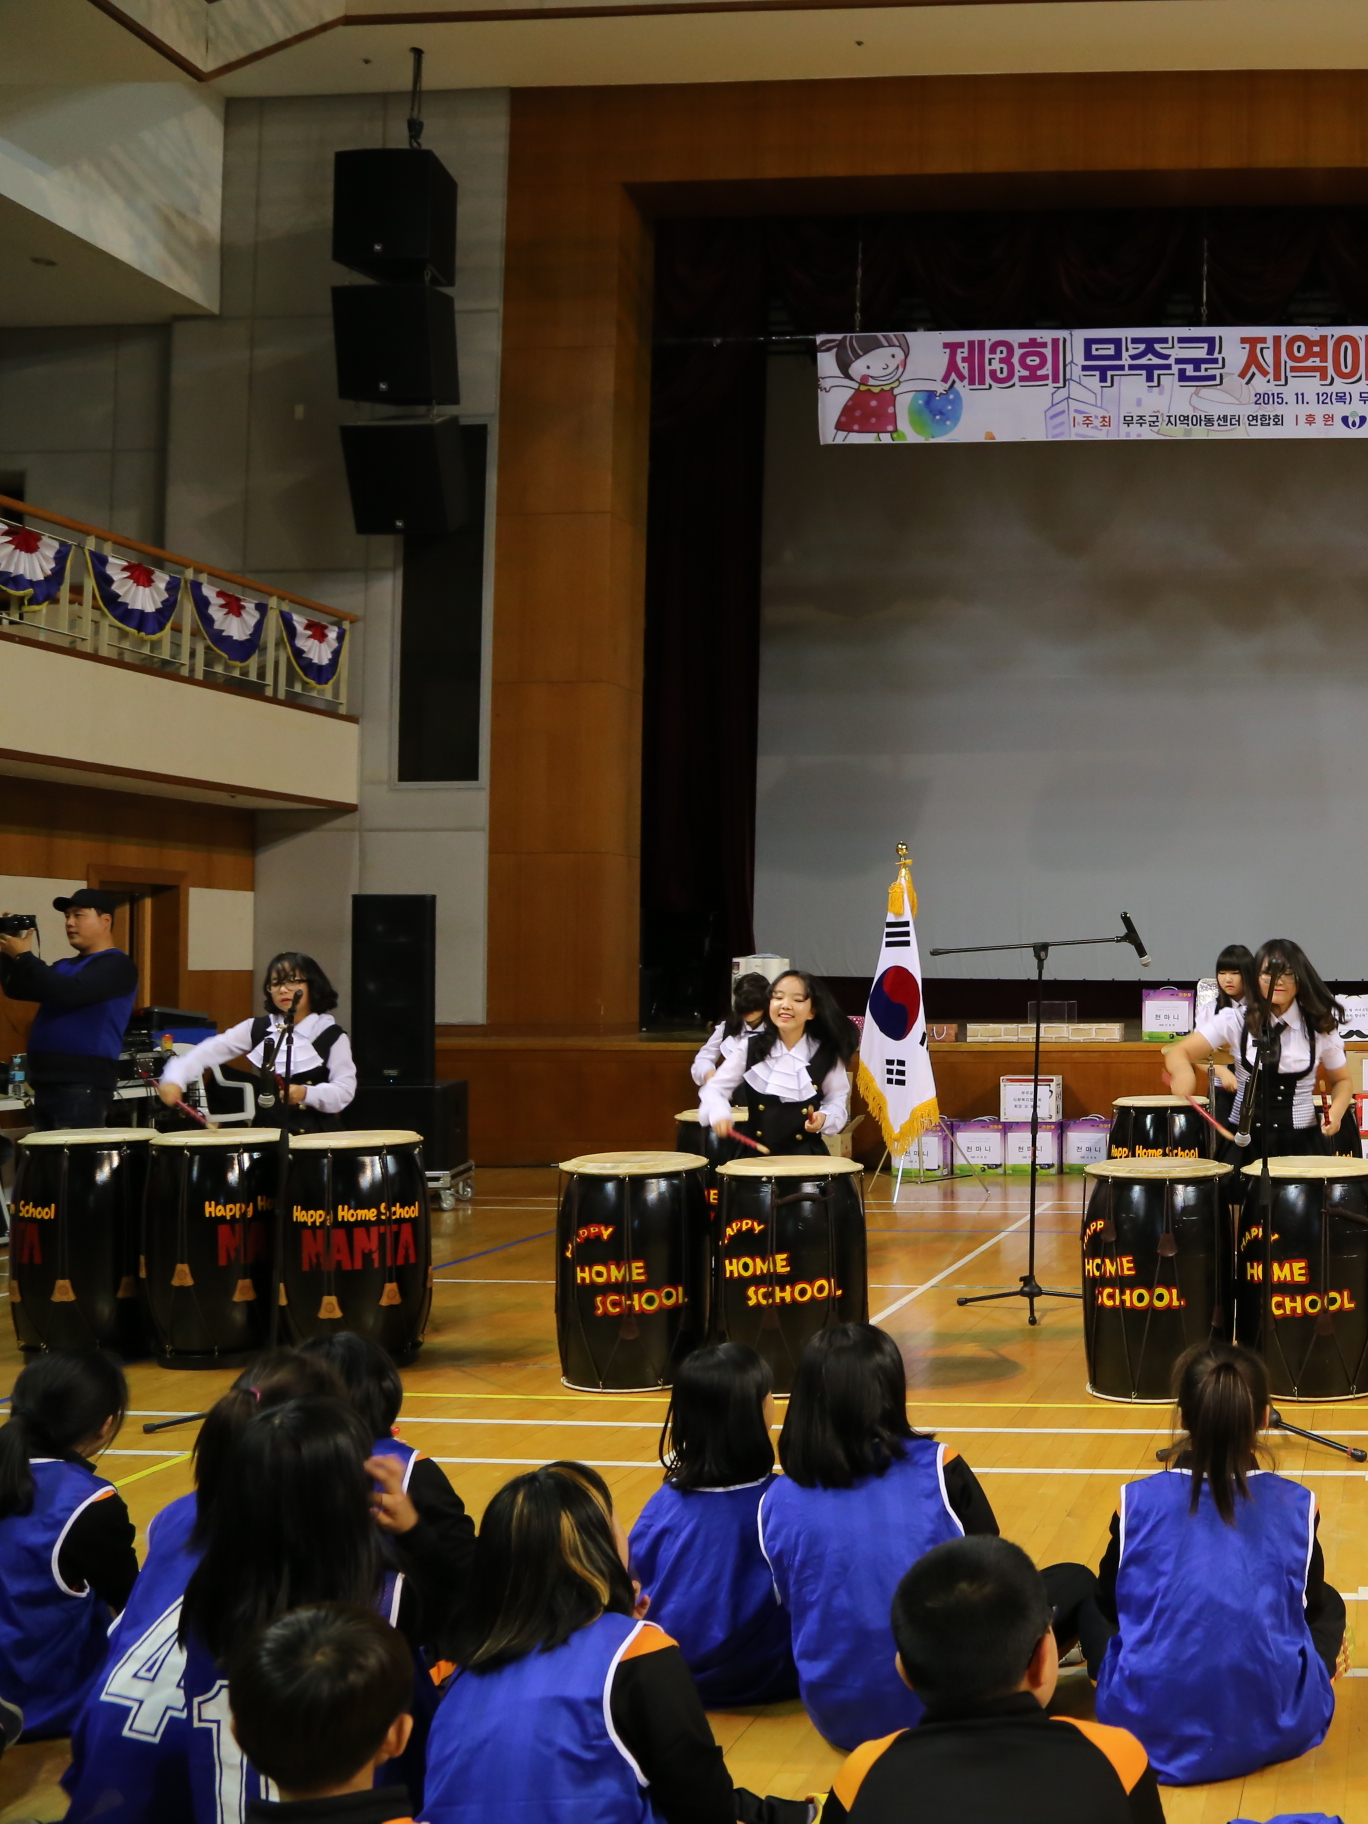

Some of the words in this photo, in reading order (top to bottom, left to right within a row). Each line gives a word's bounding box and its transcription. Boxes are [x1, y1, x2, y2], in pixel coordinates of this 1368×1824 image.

[941, 337, 1064, 387] 제3회
[1081, 336, 1221, 384] 무주군
[1254, 392, 1288, 405] 2015.
[1294, 392, 1309, 405] 11.
[1315, 391, 1353, 405] 12(목)
[1122, 414, 1160, 428] 무주군
[1166, 414, 1241, 428] 지역아동센터
[1246, 414, 1284, 427] 연합회
[1135, 1145, 1163, 1158] Home
[19, 1200, 56, 1220] School
[204, 1201, 254, 1220] Happy
[337, 1204, 378, 1222] Home
[380, 1201, 419, 1220] School
[576, 1260, 647, 1284] HOME
[724, 1252, 790, 1279] HOME
[1084, 1255, 1136, 1278] HOME
[595, 1285, 688, 1316] SCHOOL
[746, 1278, 842, 1307] SCHOOL
[1095, 1285, 1186, 1311] SCHOOL
[1270, 1289, 1356, 1318] CHOOL
